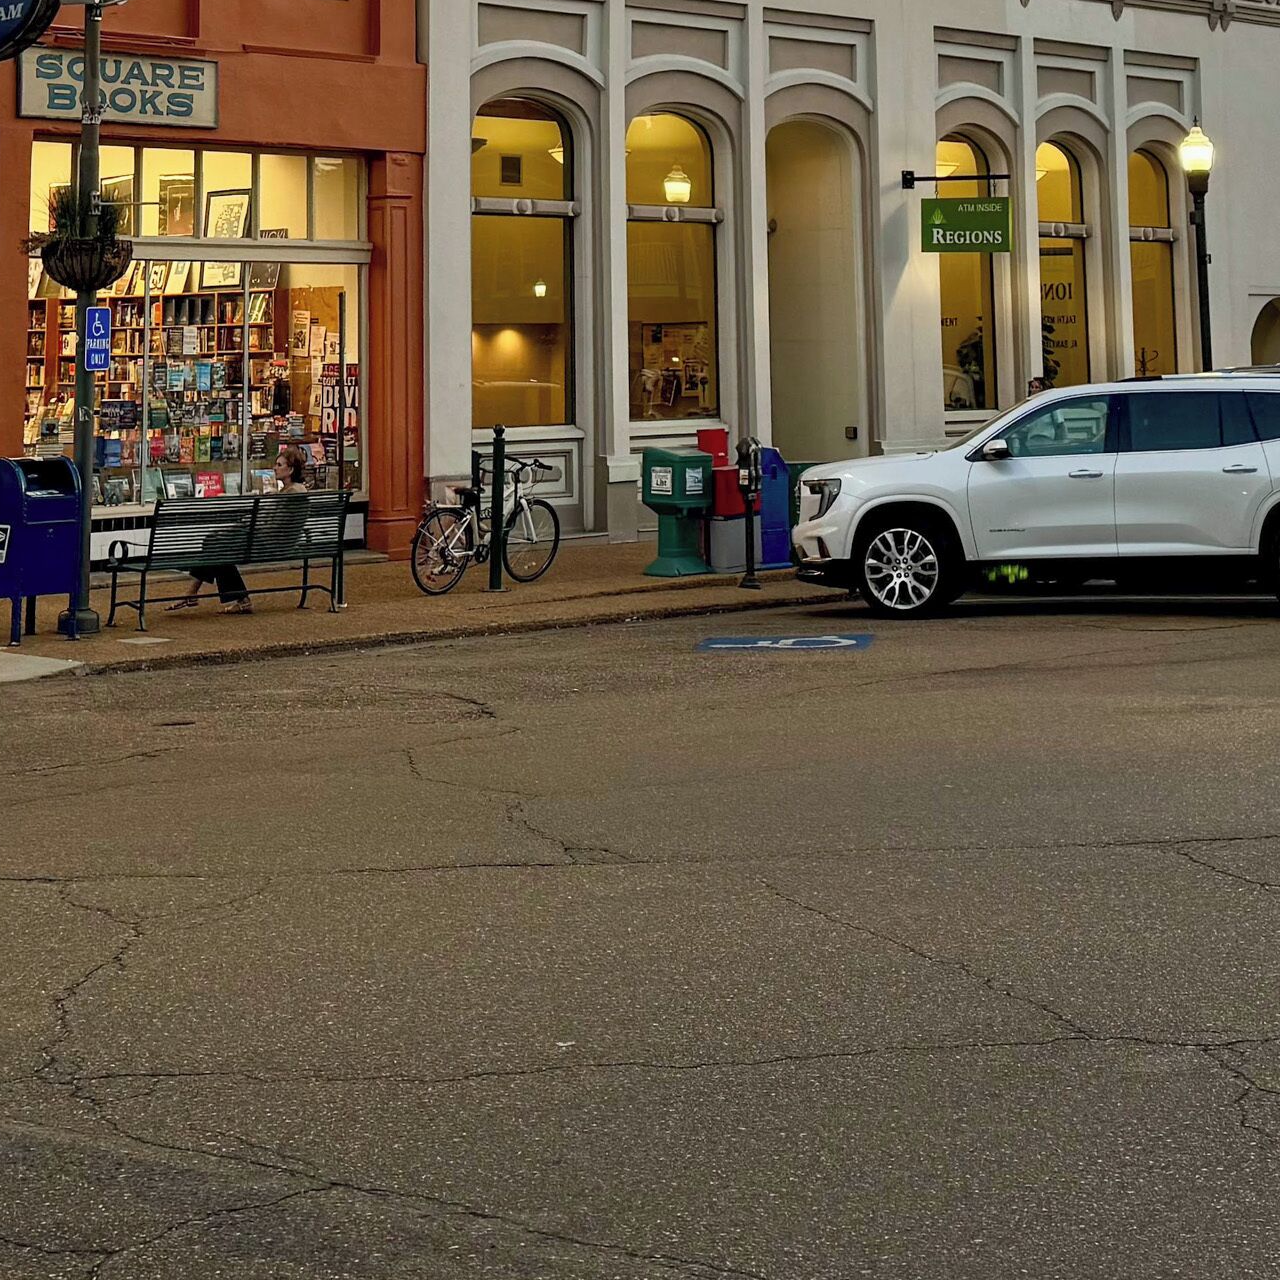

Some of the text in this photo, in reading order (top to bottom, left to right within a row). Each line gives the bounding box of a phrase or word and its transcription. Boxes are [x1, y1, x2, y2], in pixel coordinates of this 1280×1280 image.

[36, 54, 205, 91] SQUARE
[958, 203, 1003, 212] ATM INSIDE
[932, 228, 1003, 244] REGIONS
[87, 339, 109, 349] PARKING
[91, 353, 105, 365] ONLY
